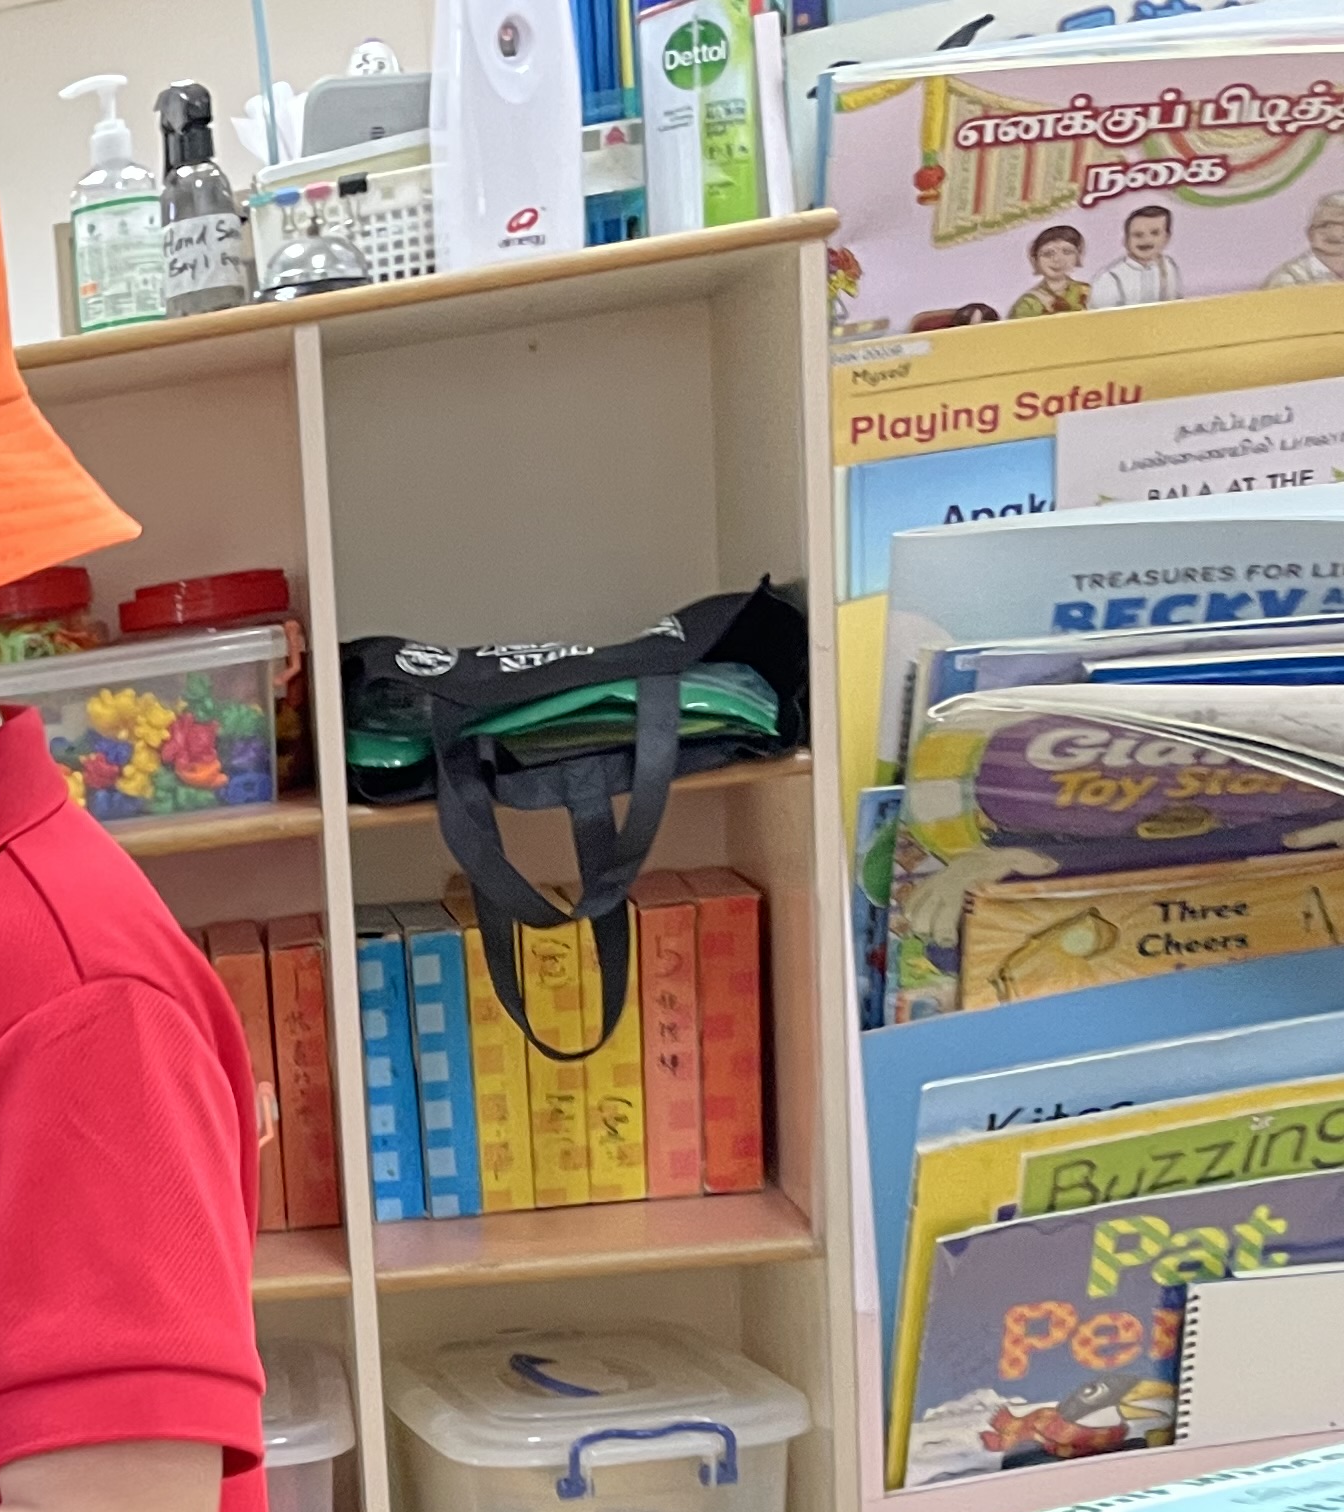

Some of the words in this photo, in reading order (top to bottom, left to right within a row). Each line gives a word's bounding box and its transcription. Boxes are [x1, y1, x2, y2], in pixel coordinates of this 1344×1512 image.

[665, 40, 726, 70] Dettol
[1081, 156, 1226, 206] நகை
[850, 403, 1000, 446] Playing
[1013, 381, 1144, 422] Safely
[1071, 564, 1236, 592] TREASURES
[1246, 562, 1303, 583] FOR
[1050, 770, 1159, 812] Toy
[1152, 899, 1250, 923] Three
[1136, 932, 1249, 958] Cheers
[1047, 1107, 1344, 1213] Buzzing
[1086, 1203, 1289, 1299] Pat
